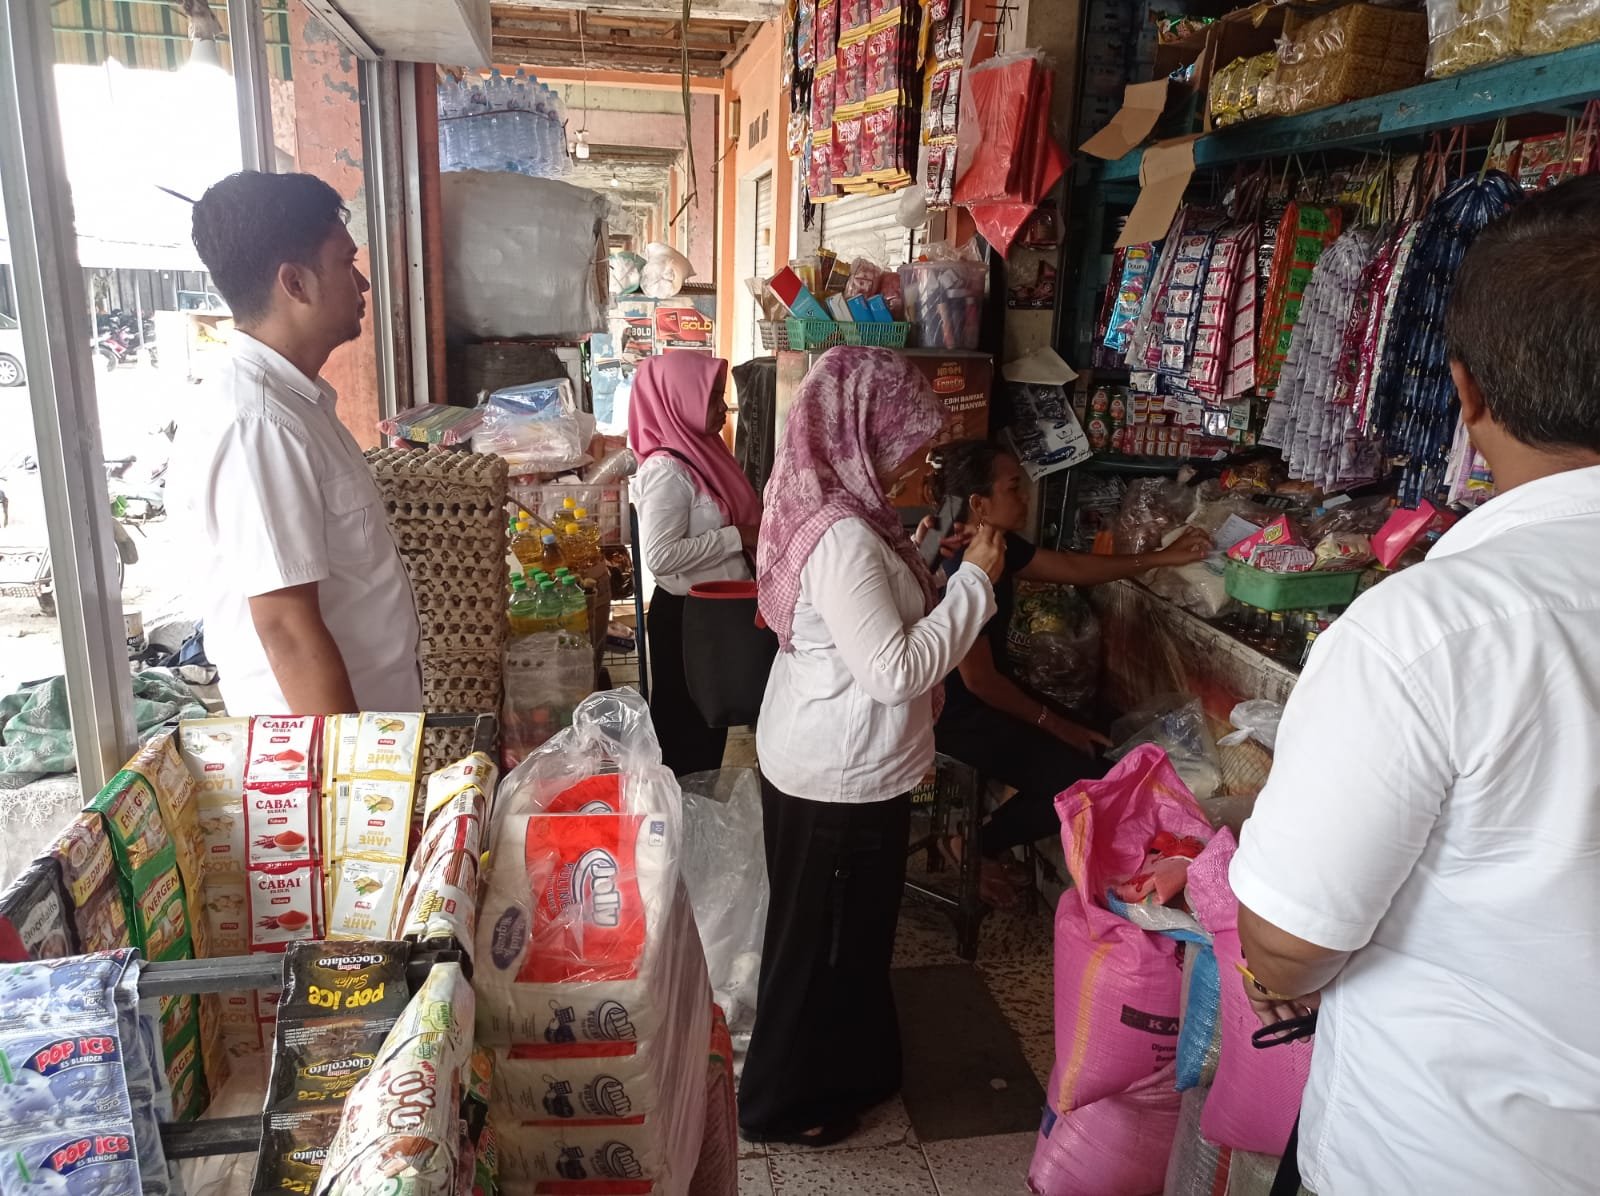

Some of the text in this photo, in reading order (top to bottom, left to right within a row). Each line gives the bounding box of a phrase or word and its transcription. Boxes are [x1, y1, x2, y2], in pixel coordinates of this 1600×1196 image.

[680, 321, 712, 331] GOLD
[262, 720, 304, 729] CABAI
[358, 834, 392, 847] JAHE
[258, 877, 303, 890] CABAI
[343, 916, 377, 931] JAHE
[318, 954, 384, 968] Cioccolato
[71, 1055, 103, 1065] BLENDER
[308, 1057, 375, 1075] Cioccolato
[87, 1153, 118, 1164] BLENDER
